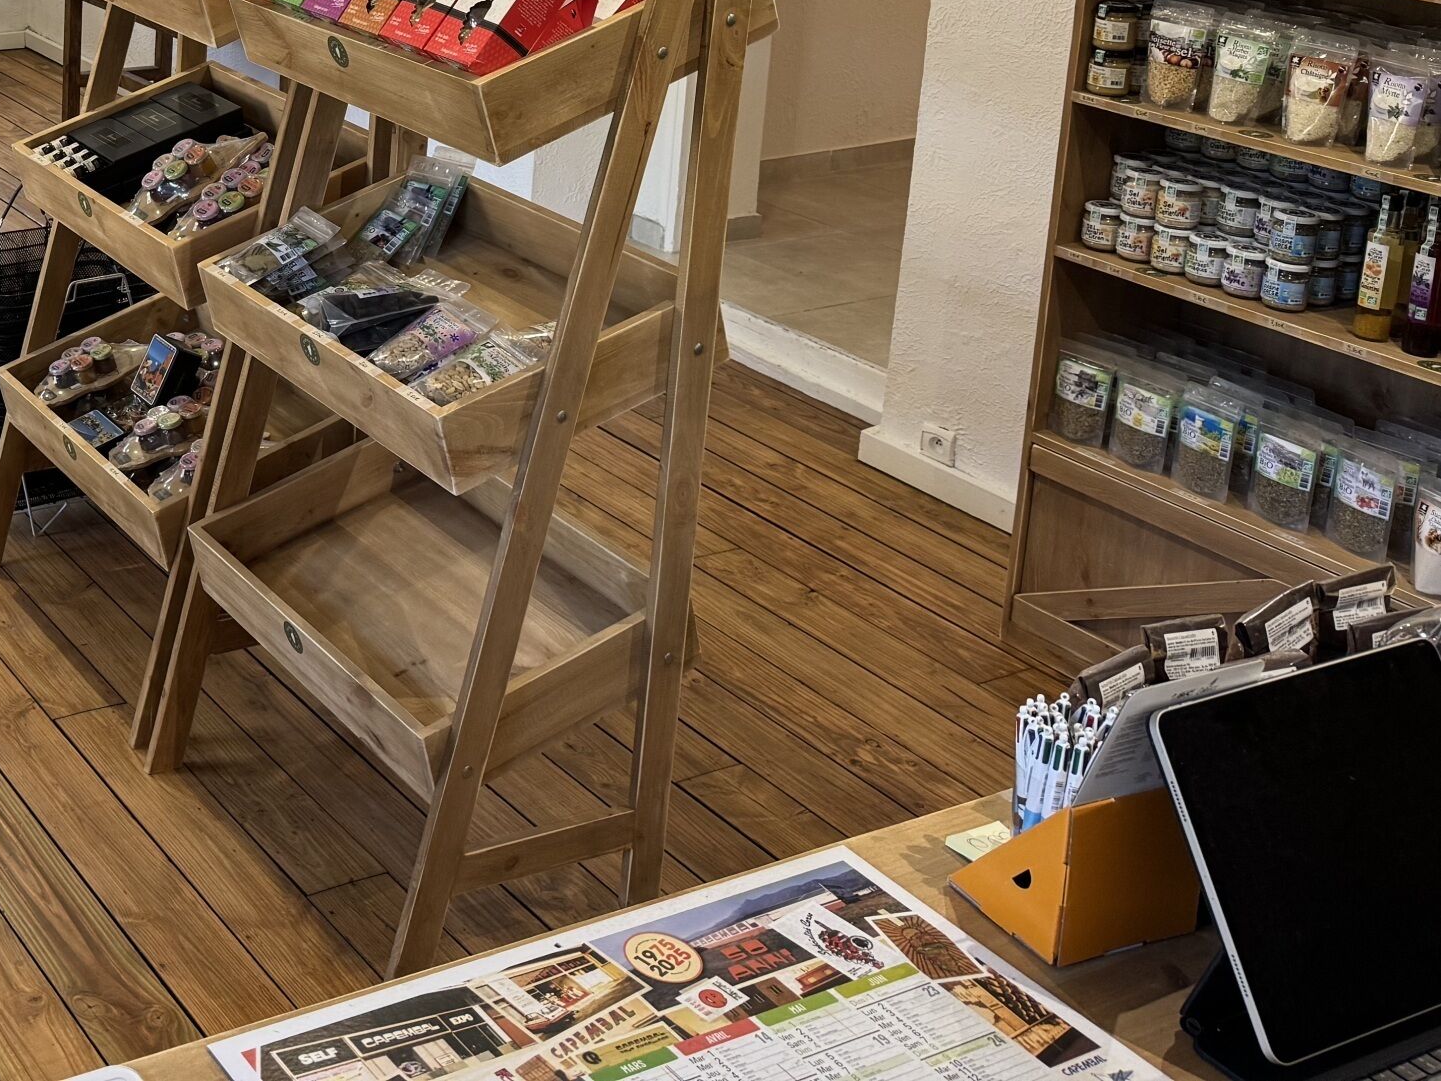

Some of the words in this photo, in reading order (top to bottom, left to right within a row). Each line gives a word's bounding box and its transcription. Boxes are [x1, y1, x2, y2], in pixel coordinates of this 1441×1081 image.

[1176, 48, 1192, 58] sel
[1163, 200, 1174, 208] Sel
[633, 938, 676, 967] 1975
[649, 947, 691, 977] 2025
[866, 974, 889, 986] JUIN
[922, 985, 940, 998] 23
[787, 1003, 807, 1015] MAI
[861, 1008, 878, 1017] Lun
[878, 1002, 887, 1010] 2
[869, 1014, 886, 1023] Mar
[886, 1009, 896, 1017] 3
[878, 1021, 895, 1030] Mer
[903, 1022, 913, 1030] 5
[361, 1022, 440, 1048] CAPEMBAL
[705, 1031, 731, 1044] AVRIL
[754, 1031, 773, 1043] 14
[778, 1033, 795, 1041] Ven
[796, 1027, 805, 1036] 2
[911, 1029, 921, 1037] 6
[787, 1039, 806, 1049] Sam
[803, 1034, 813, 1042] 3
[872, 1034, 891, 1046] 19
[904, 1041, 923, 1051] Sam
[987, 1033, 1007, 1048] 24
[298, 1047, 339, 1066] SELF
[688, 1055, 706, 1065] Mar
[808, 1058, 825, 1067] Lun
[825, 1052, 835, 1060] 5
[620, 1060, 647, 1074] MARS
[696, 1062, 714, 1072] Mer
[714, 1057, 724, 1065] 2
[816, 1065, 834, 1074] Mar
[834, 1059, 844, 1067] 6
[933, 1064, 951, 1075] Mar
[949, 1059, 963, 1069] 10
[957, 1066, 973, 1076] 11
[706, 1070, 721, 1079] Jeu
[722, 1064, 732, 1072] 3
[825, 1071, 841, 1081] Mer
[967, 1073, 983, 1081] 12
